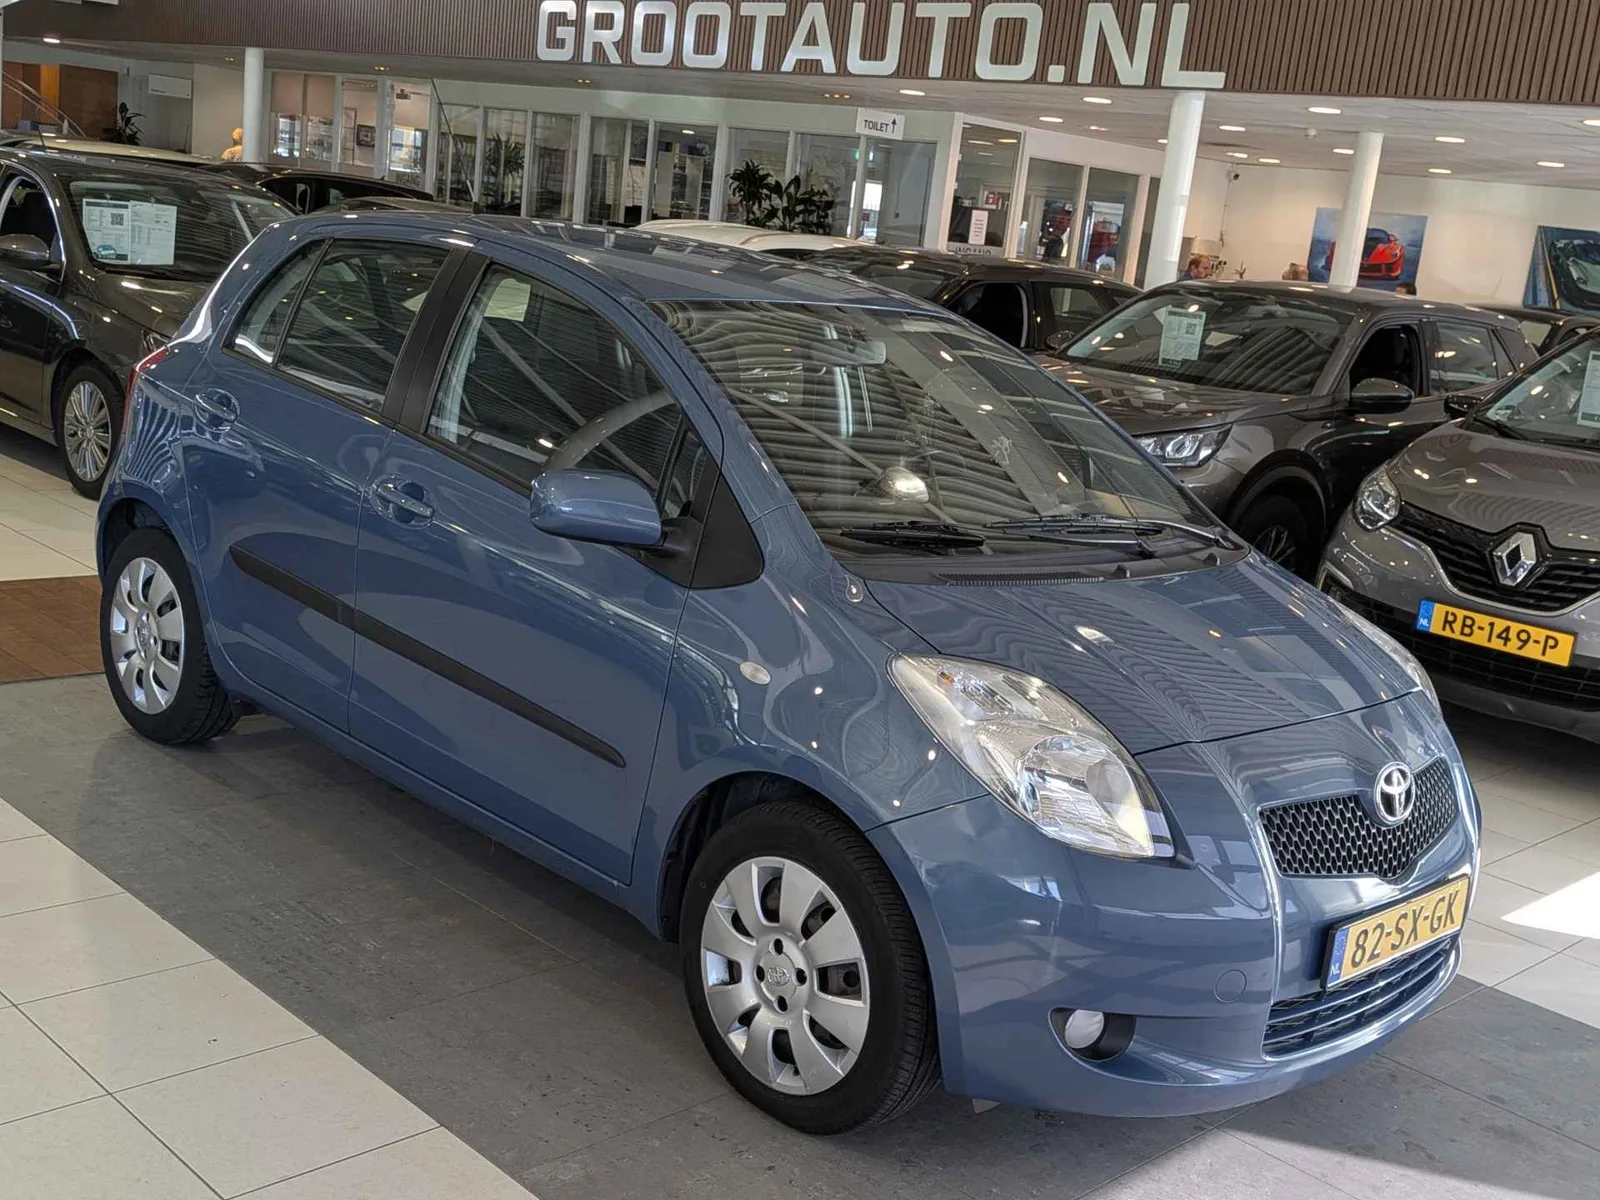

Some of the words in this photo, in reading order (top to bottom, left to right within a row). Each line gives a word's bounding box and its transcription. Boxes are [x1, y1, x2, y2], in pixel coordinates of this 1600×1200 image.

[537, 0, 1226, 89] GROOTAUTO.NL
[863, 119, 890, 132] TOILET
[1419, 617, 1429, 627] NL
[1441, 610, 1559, 656] RB-149-P
[1351, 890, 1459, 968] 82-SX-GK
